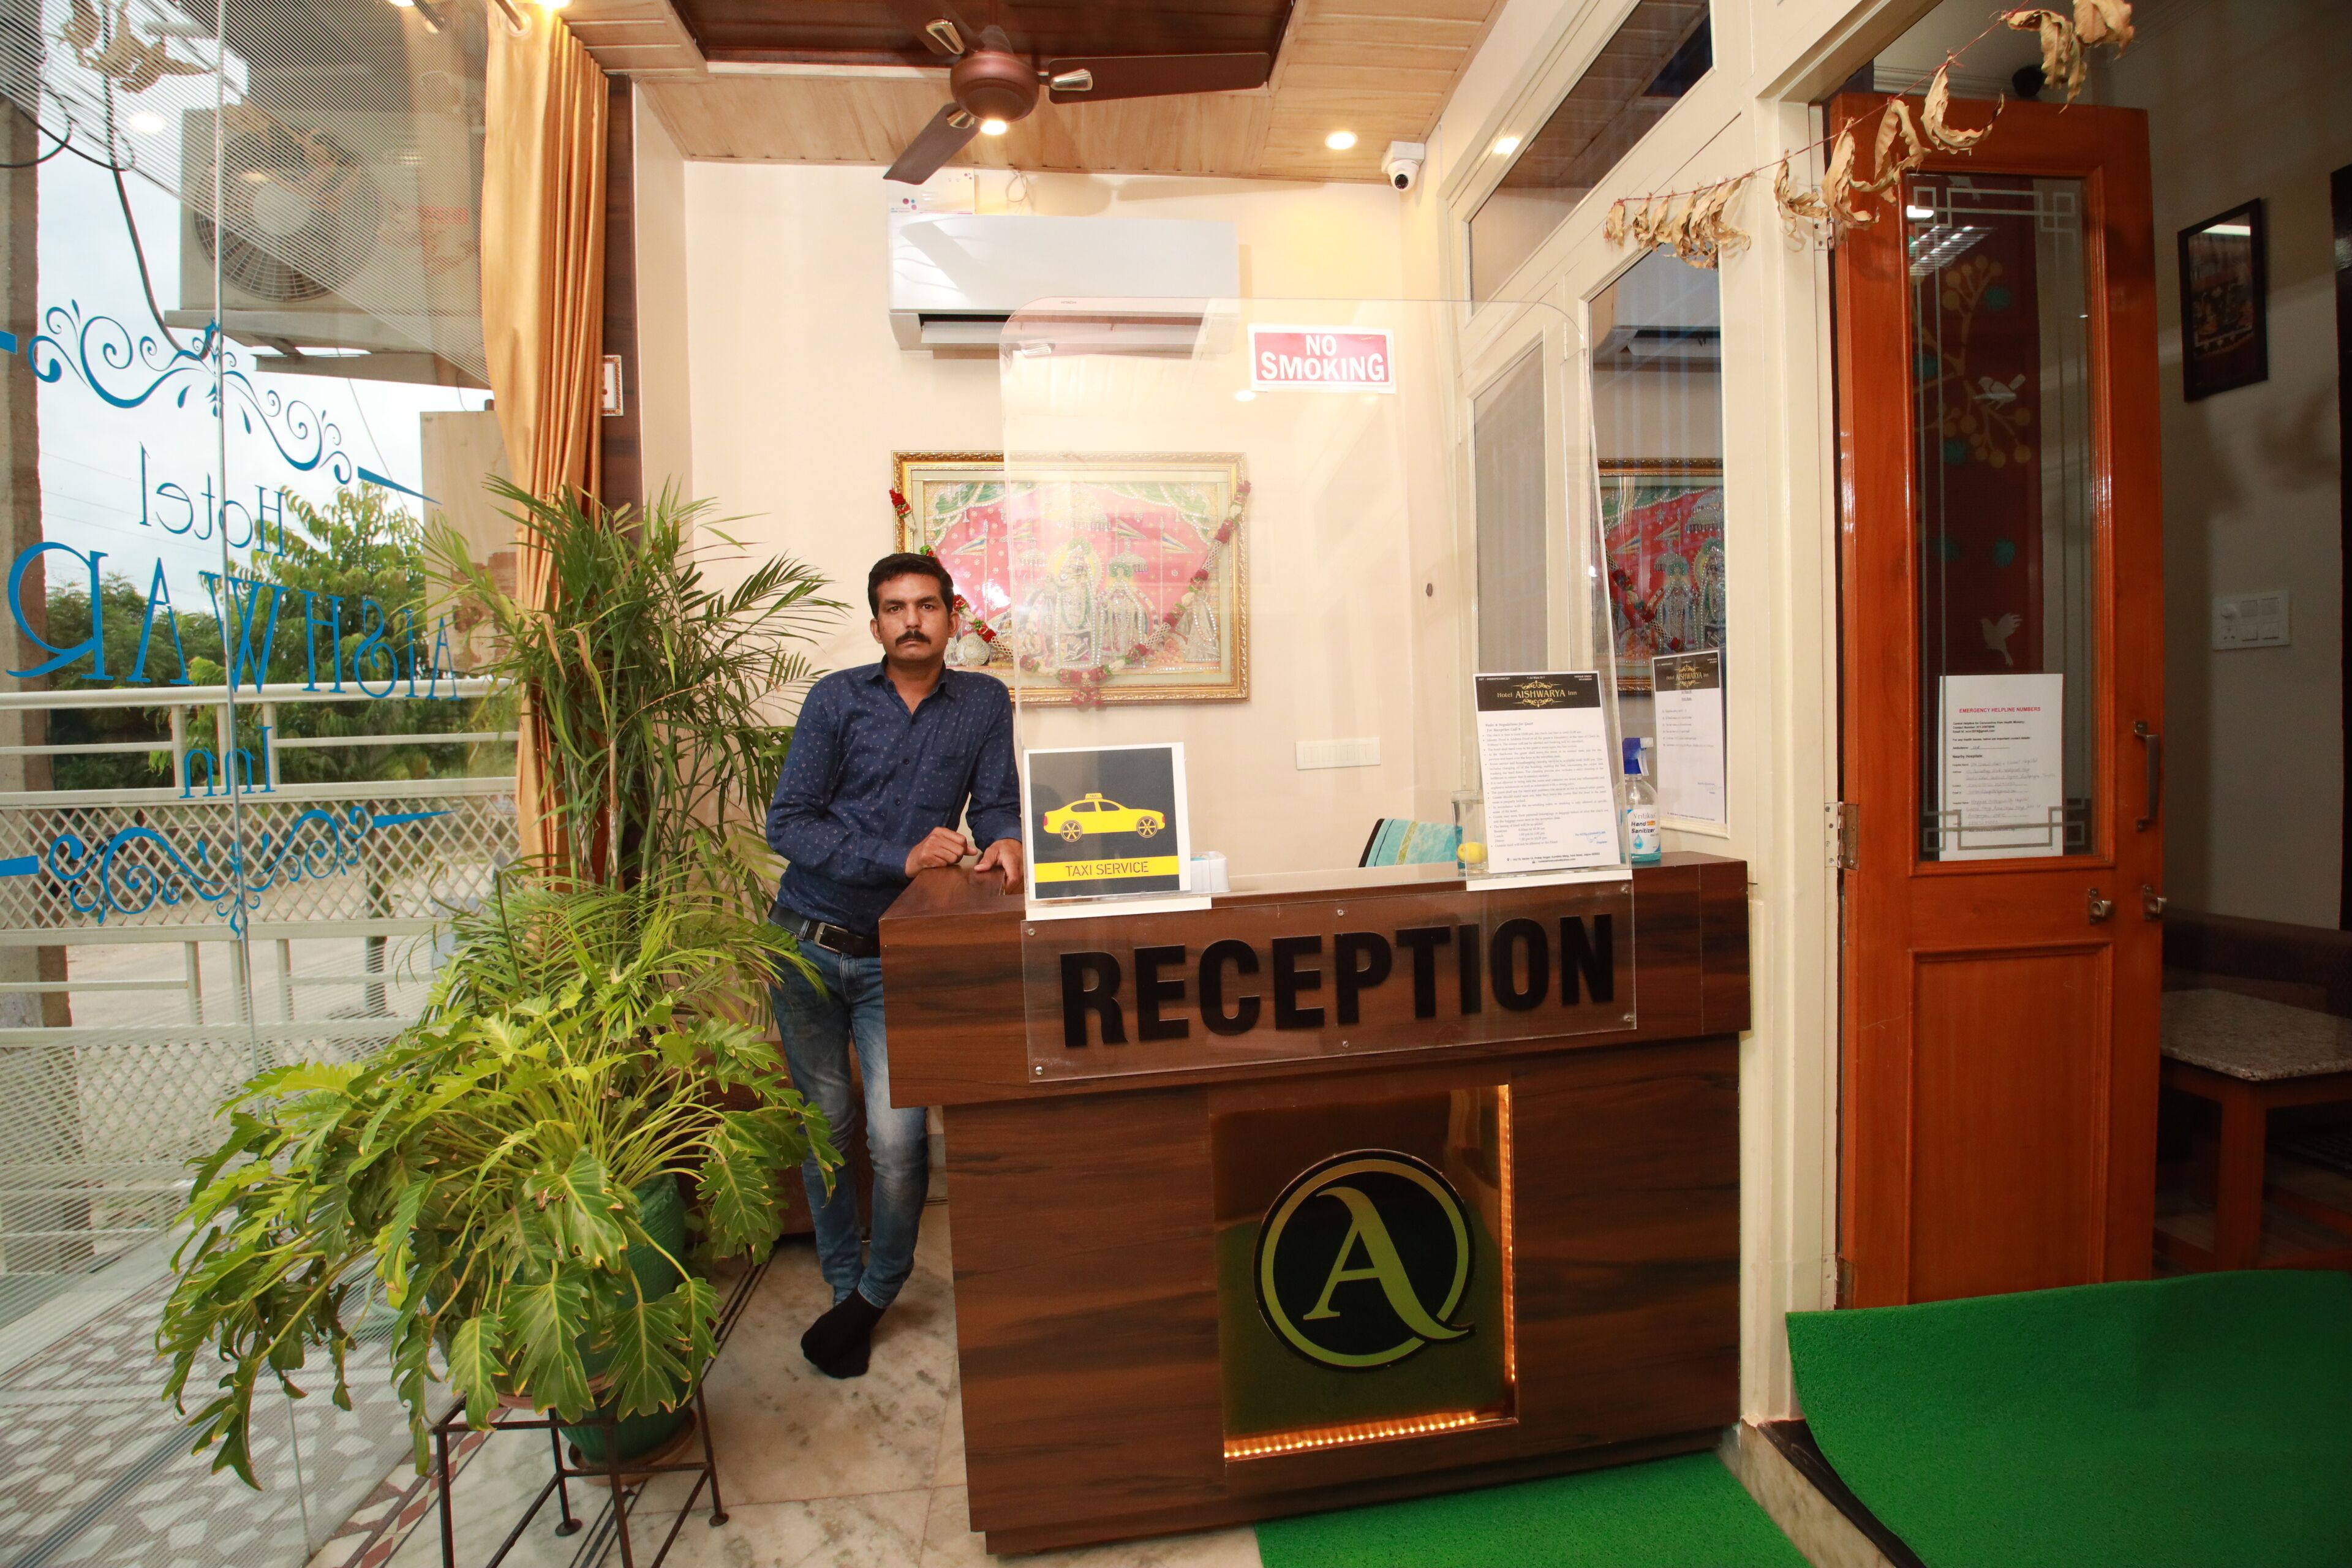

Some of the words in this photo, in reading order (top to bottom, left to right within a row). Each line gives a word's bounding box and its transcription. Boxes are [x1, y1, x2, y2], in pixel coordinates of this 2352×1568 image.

[1305, 334, 1337, 356] NO
[1261, 351, 1385, 381] SMOKING
[1675, 672, 1702, 680] AISHWARYA
[1515, 690, 1566, 699] AISHWARYA
[1065, 865, 1092, 877] TAXI
[1096, 861, 1149, 875] SERVICE
[1060, 914, 1615, 1047] RECEPTION
